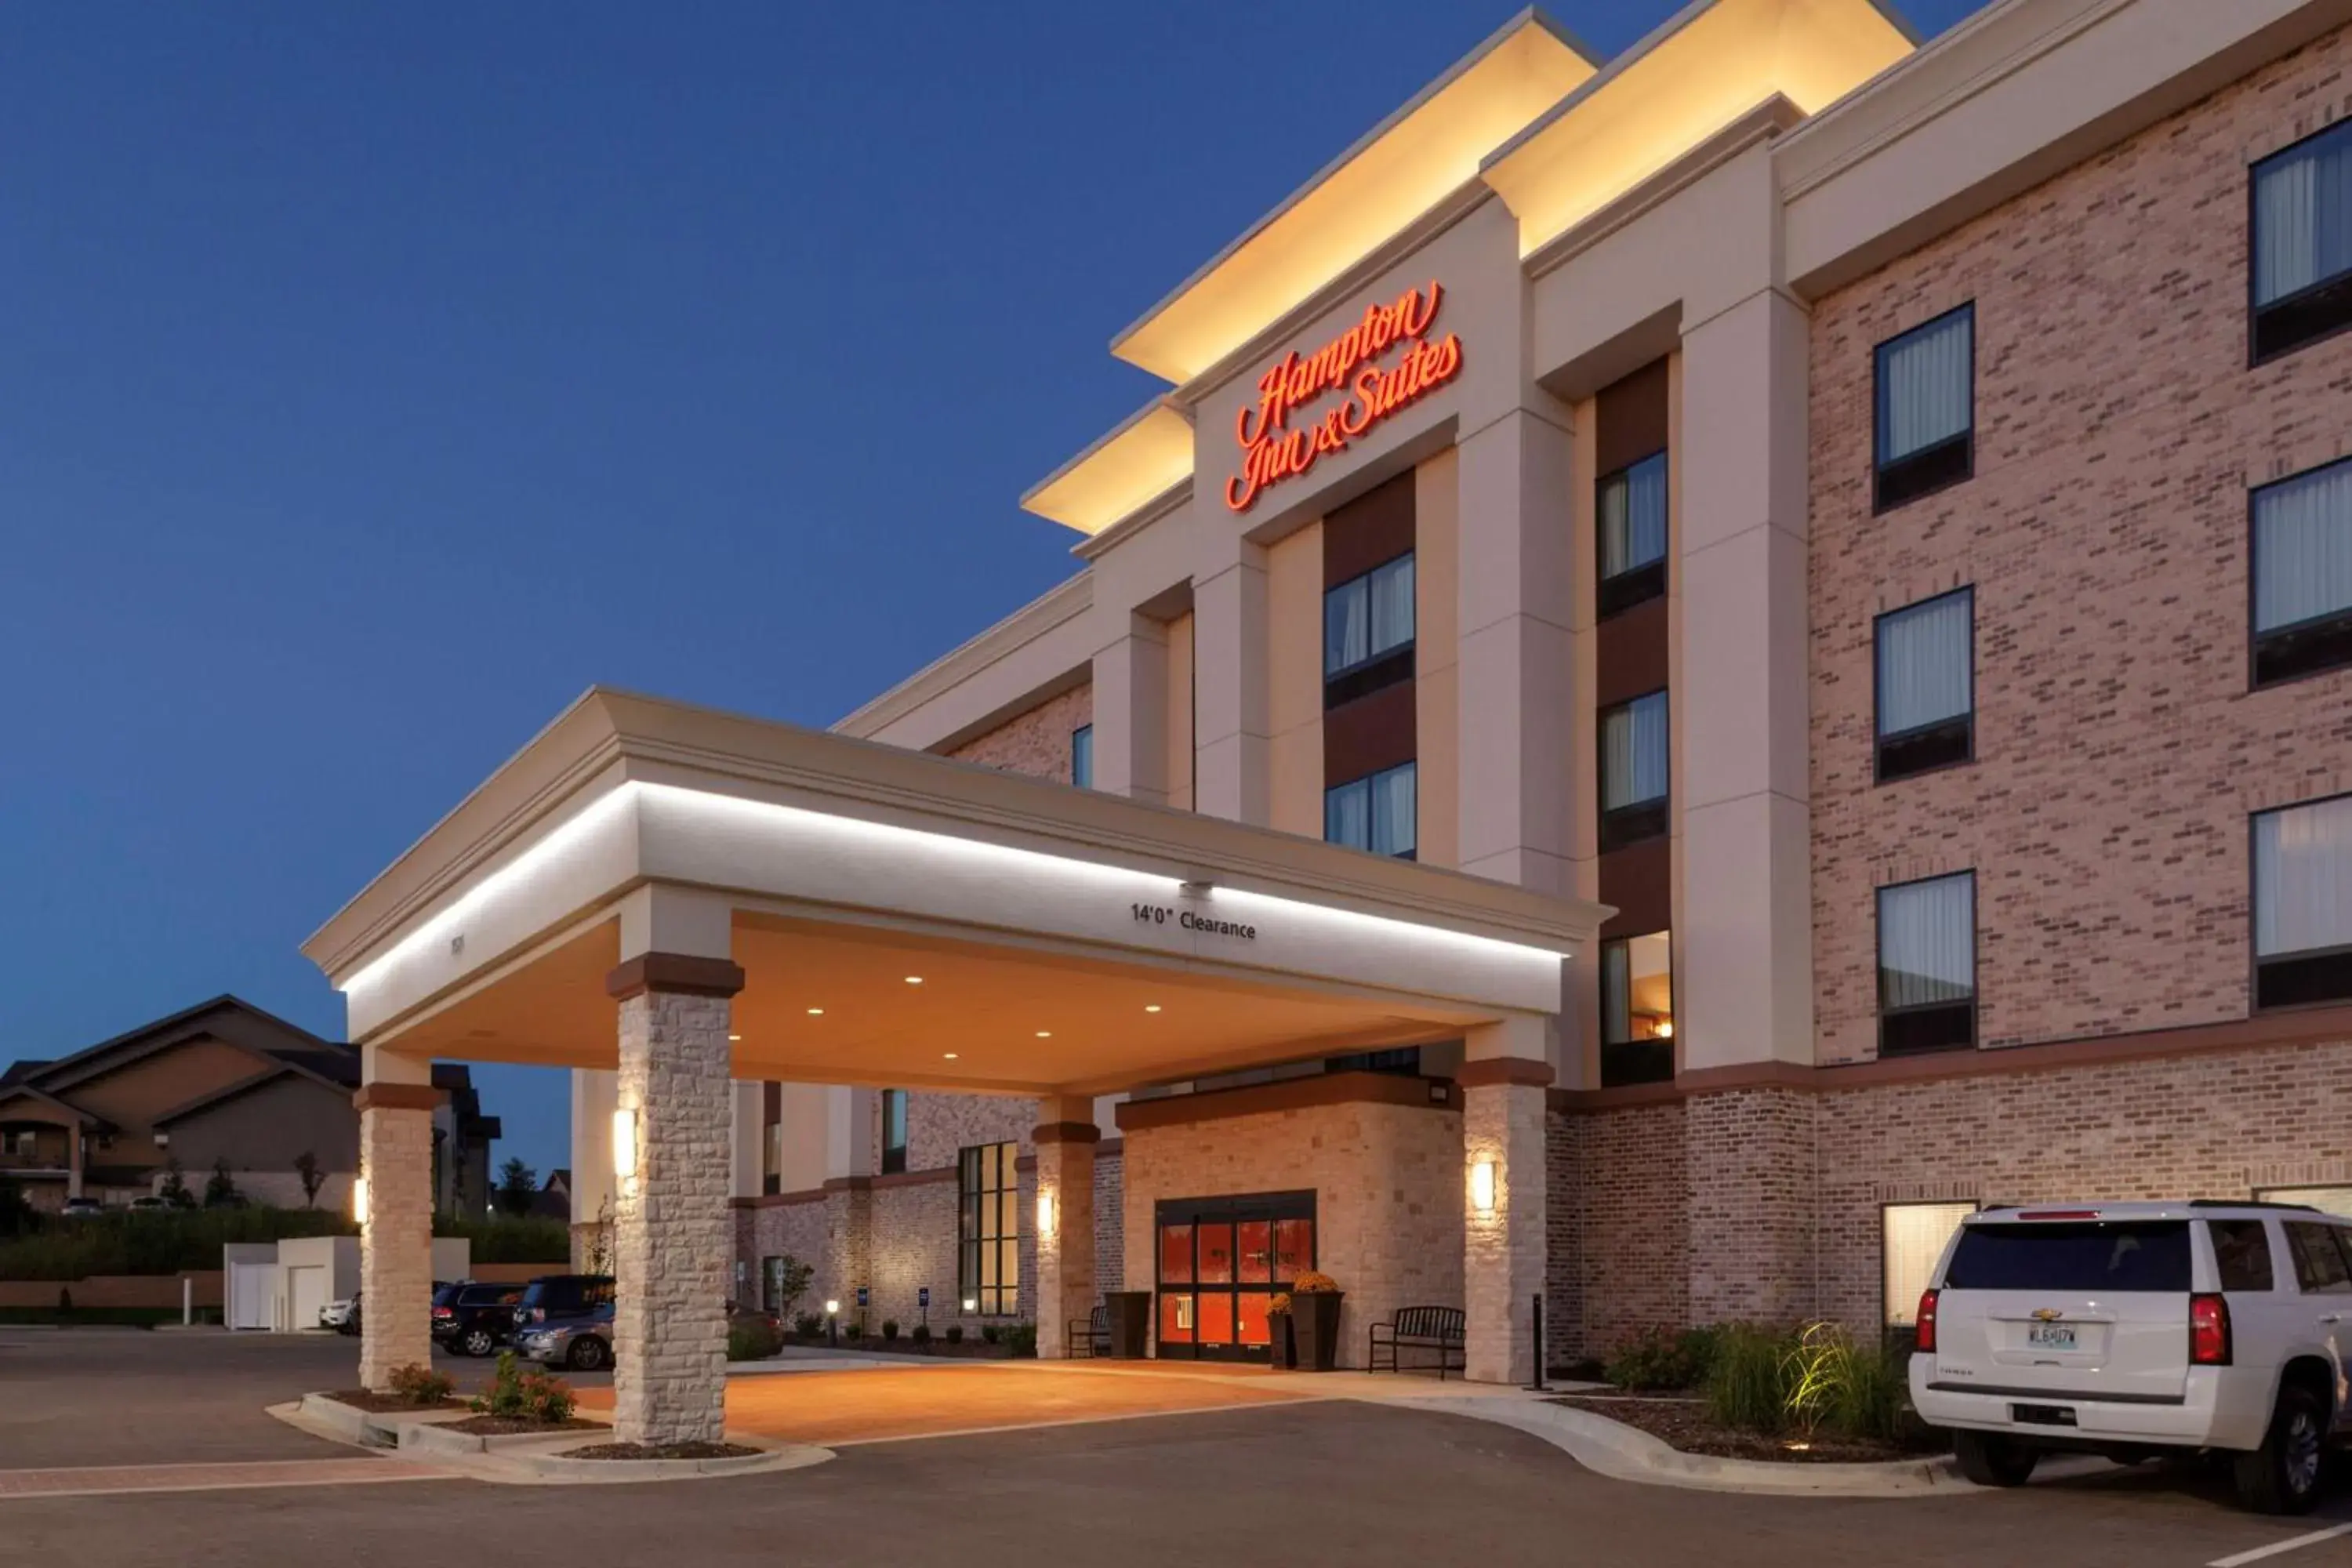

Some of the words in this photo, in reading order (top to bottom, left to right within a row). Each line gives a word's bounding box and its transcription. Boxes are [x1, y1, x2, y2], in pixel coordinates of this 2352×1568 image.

[1226, 424, 1319, 512] Inn
[1317, 408, 1346, 451] &
[1340, 333, 1461, 435] Suites
[1238, 279, 1443, 449] Hampton
[1131, 903, 1174, 924] 14'0"
[1180, 911, 1256, 939] Clearance
